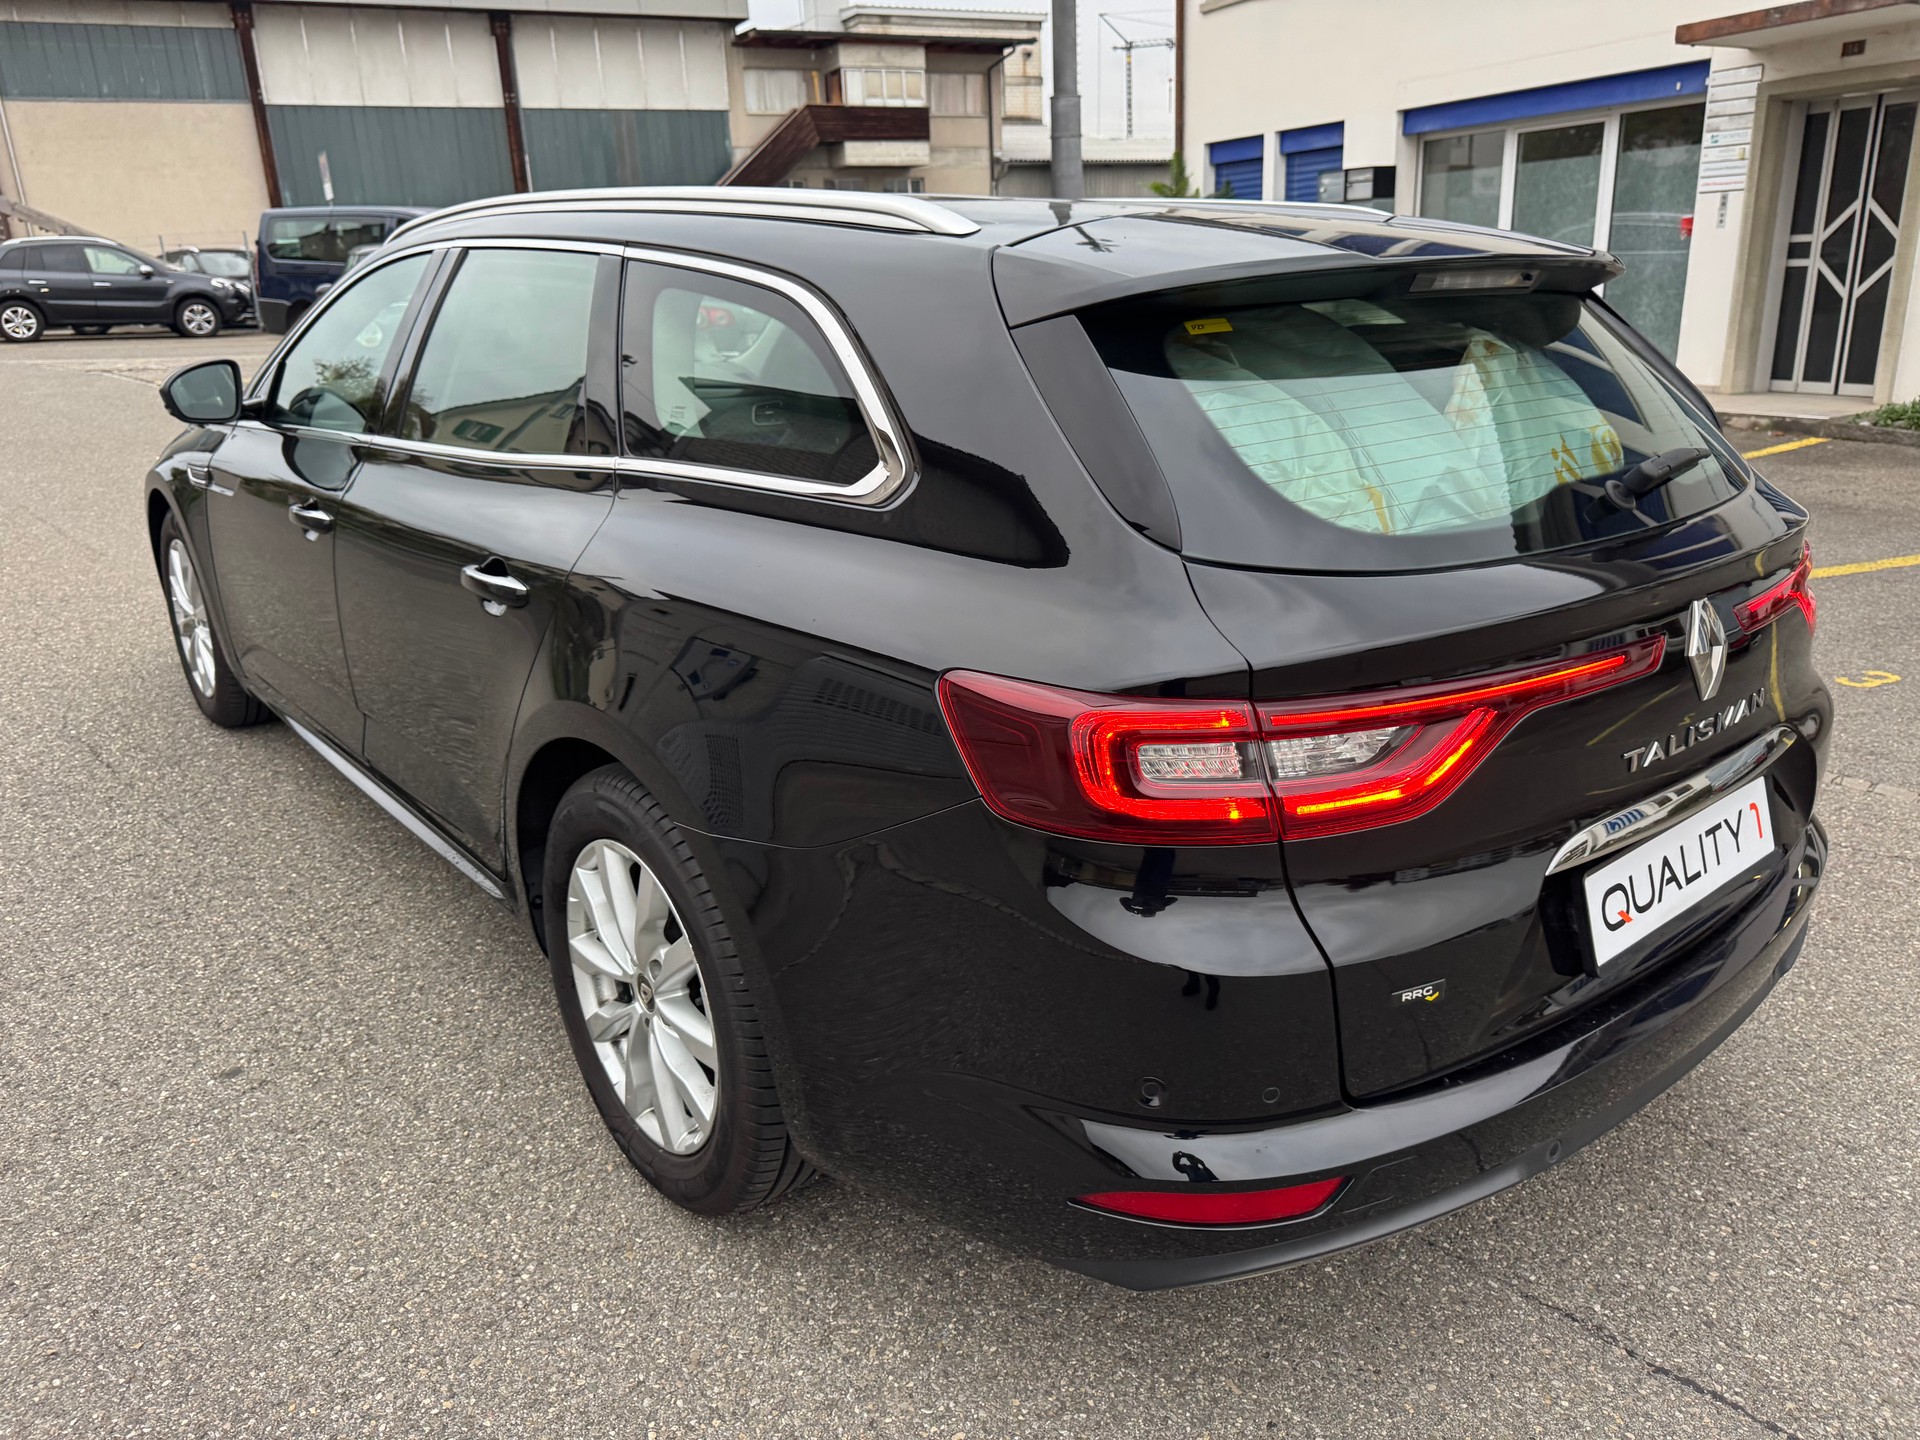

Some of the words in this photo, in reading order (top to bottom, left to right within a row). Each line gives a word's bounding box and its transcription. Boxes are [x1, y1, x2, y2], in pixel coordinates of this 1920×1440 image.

[1622, 687, 1765, 774] TALISMAN
[1601, 808, 1743, 932] QUALITY
[1749, 801, 1763, 839] 1
[1401, 985, 1434, 1003] RRG
